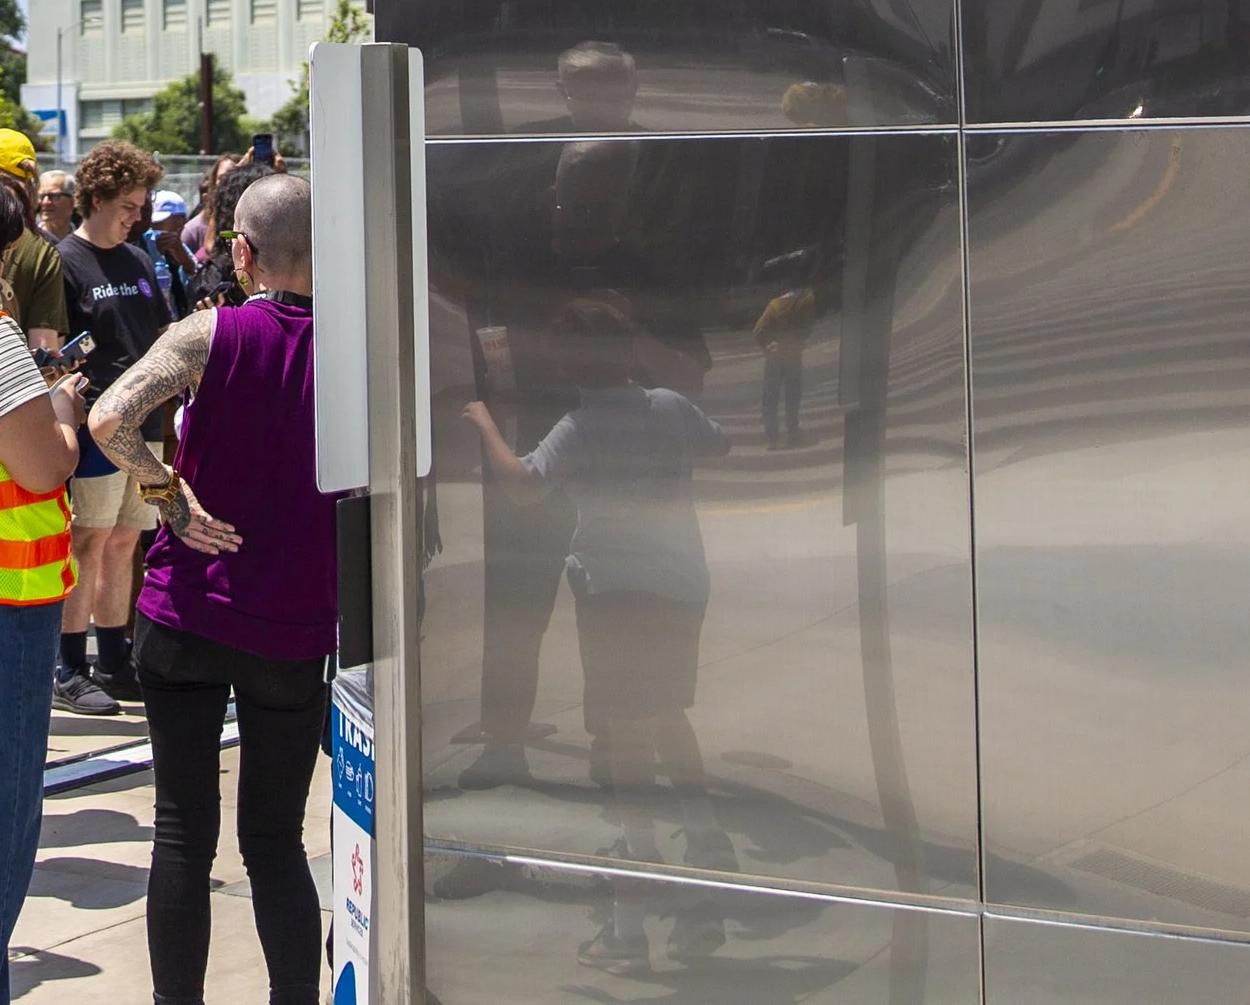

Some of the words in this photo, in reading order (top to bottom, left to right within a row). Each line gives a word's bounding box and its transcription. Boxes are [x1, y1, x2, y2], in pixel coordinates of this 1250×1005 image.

[92, 283, 119, 300] Ride
[120, 283, 138, 295] the
[346, 897, 369, 931] REPUBLIC
